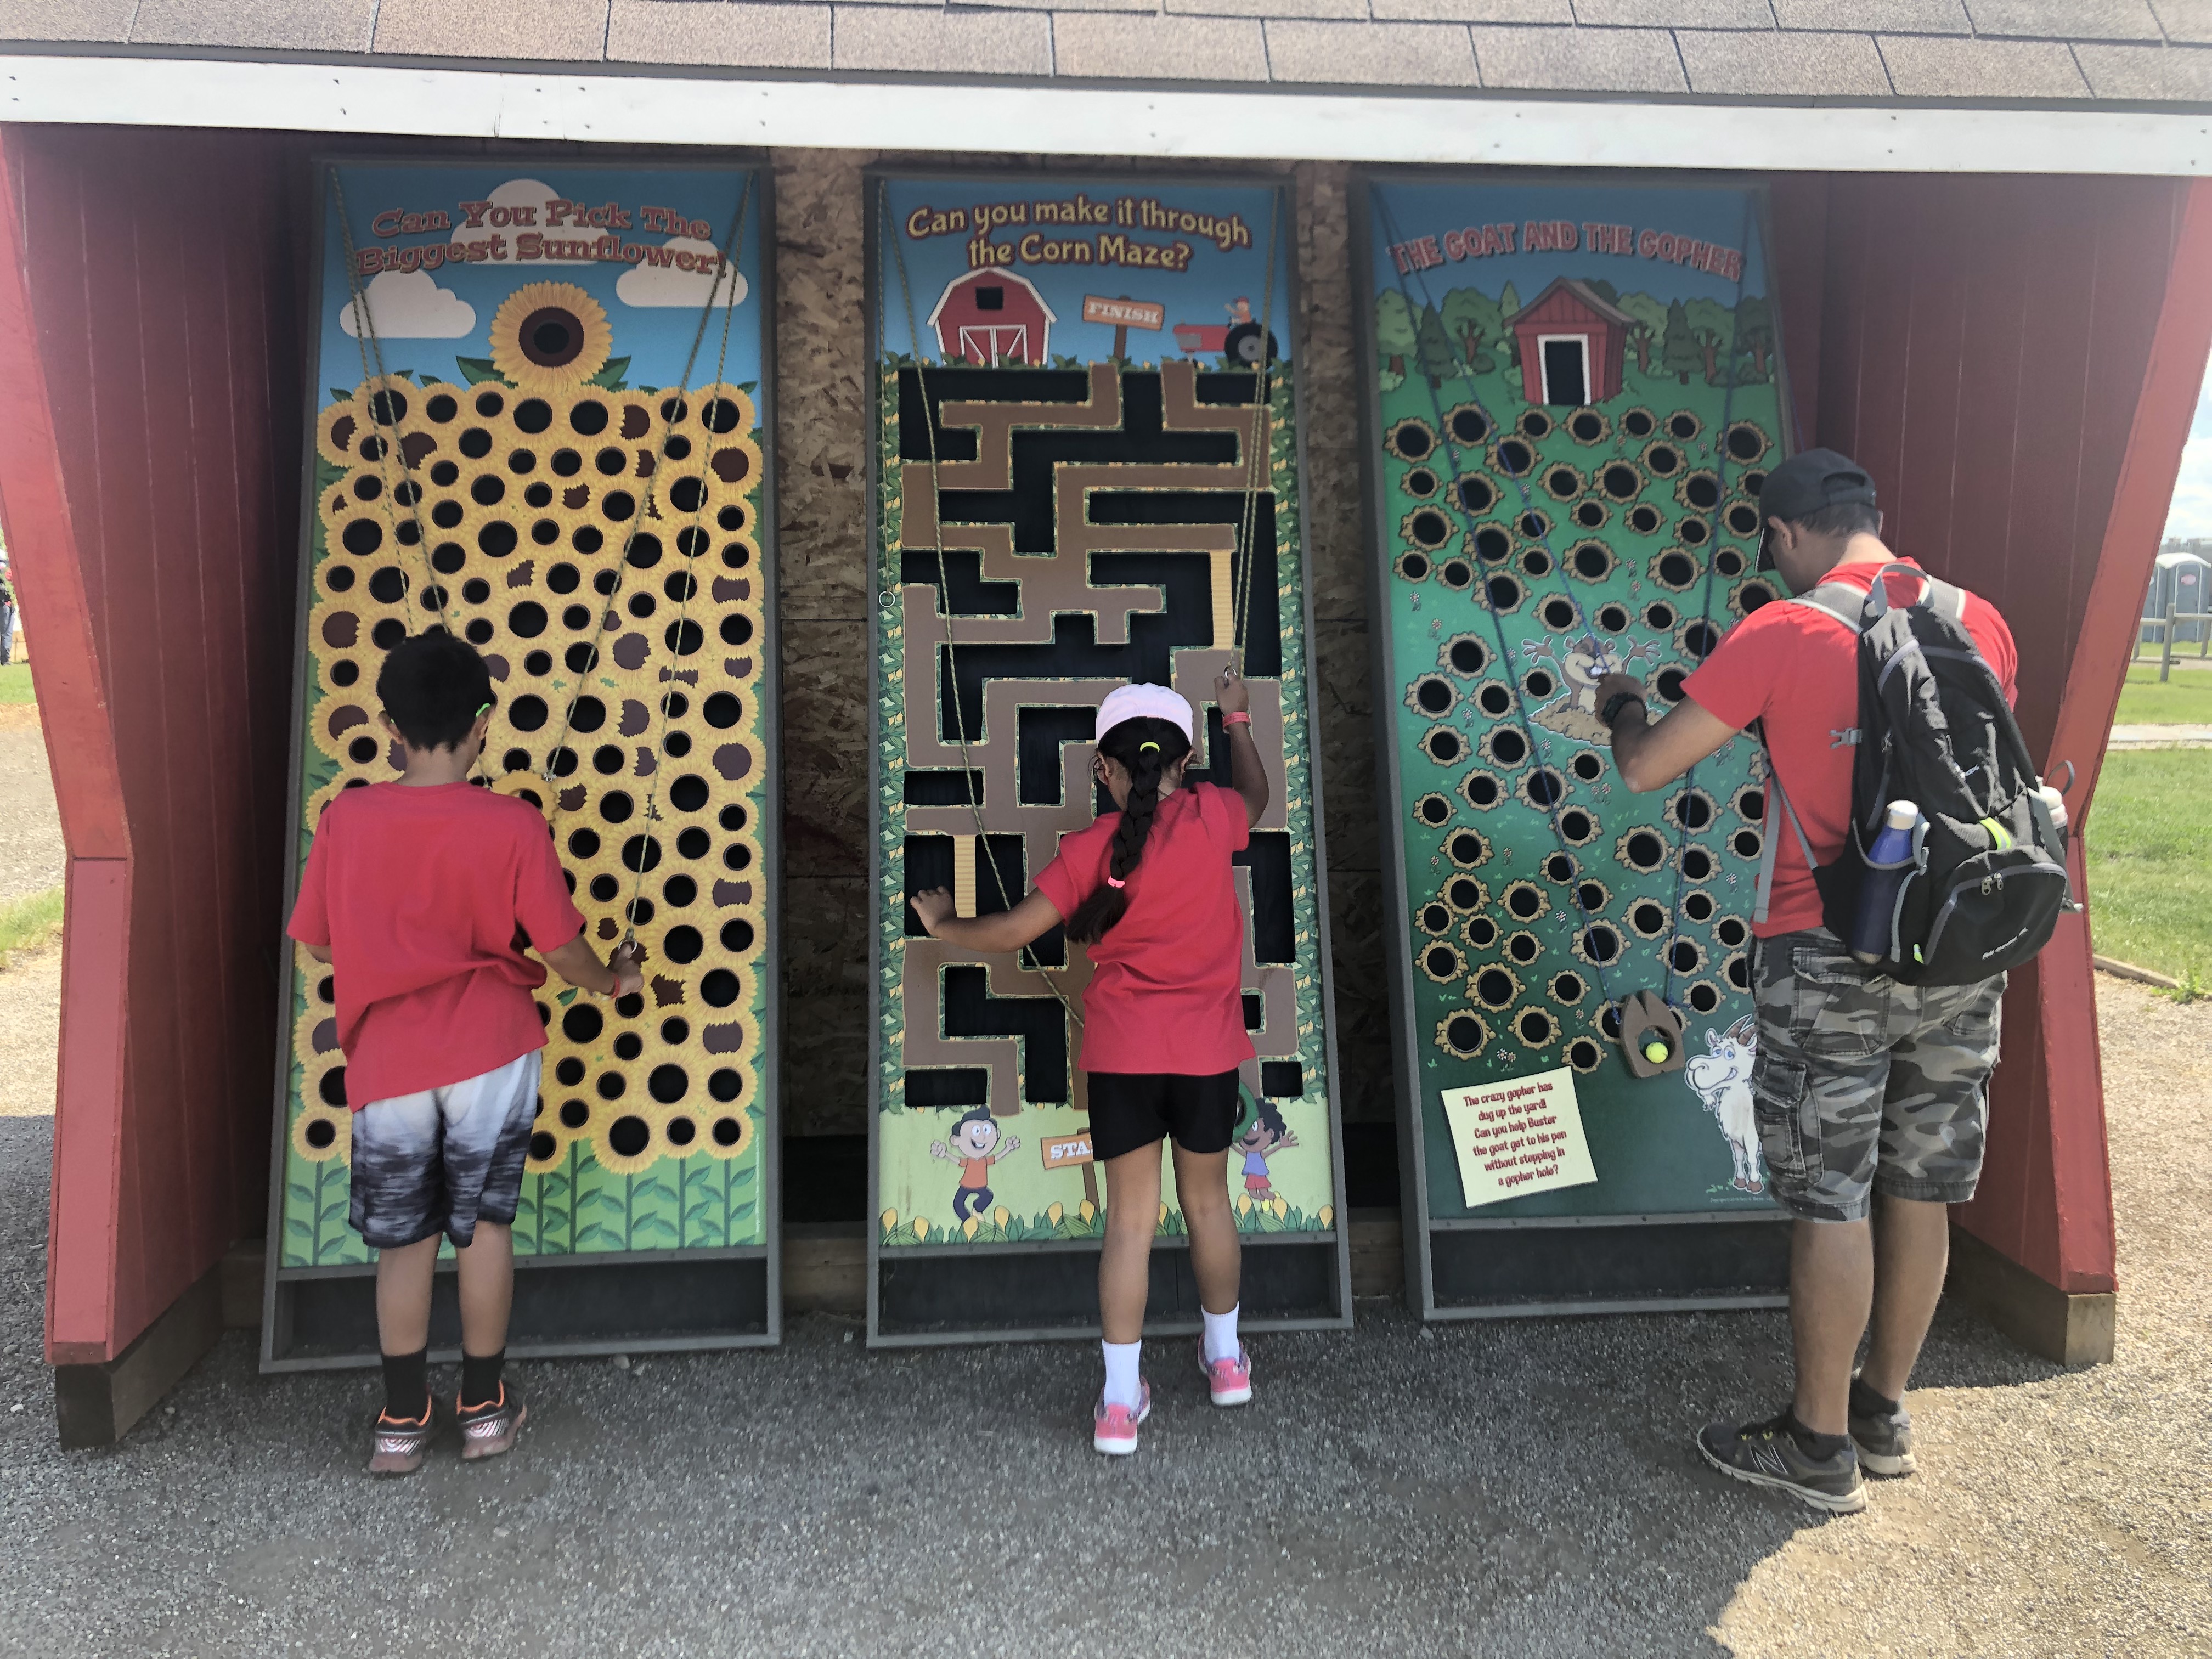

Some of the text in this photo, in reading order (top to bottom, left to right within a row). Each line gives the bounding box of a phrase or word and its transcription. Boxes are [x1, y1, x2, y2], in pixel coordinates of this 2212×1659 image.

[372, 199, 712, 240] Can You Pick The
[907, 194, 1251, 249] Can you make it through
[356, 233, 509, 275] Biggest
[969, 233, 1192, 272] the Corn Maze?
[1386, 221, 1745, 283] THE GOAT AND THE GOPHER
[1088, 302, 1159, 323] FINISH
[1463, 1082, 1553, 1107] The crazy gopher has
[1478, 1098, 1547, 1122] dug up the yard!
[1474, 1115, 1557, 1138] Can you help Buster
[1050, 1140, 1093, 1160] STA
[1472, 1130, 1567, 1156] the goat get to his pen
[1484, 1147, 1566, 1171] without stepping in
[1498, 1163, 1559, 1187] a gopher hole?
